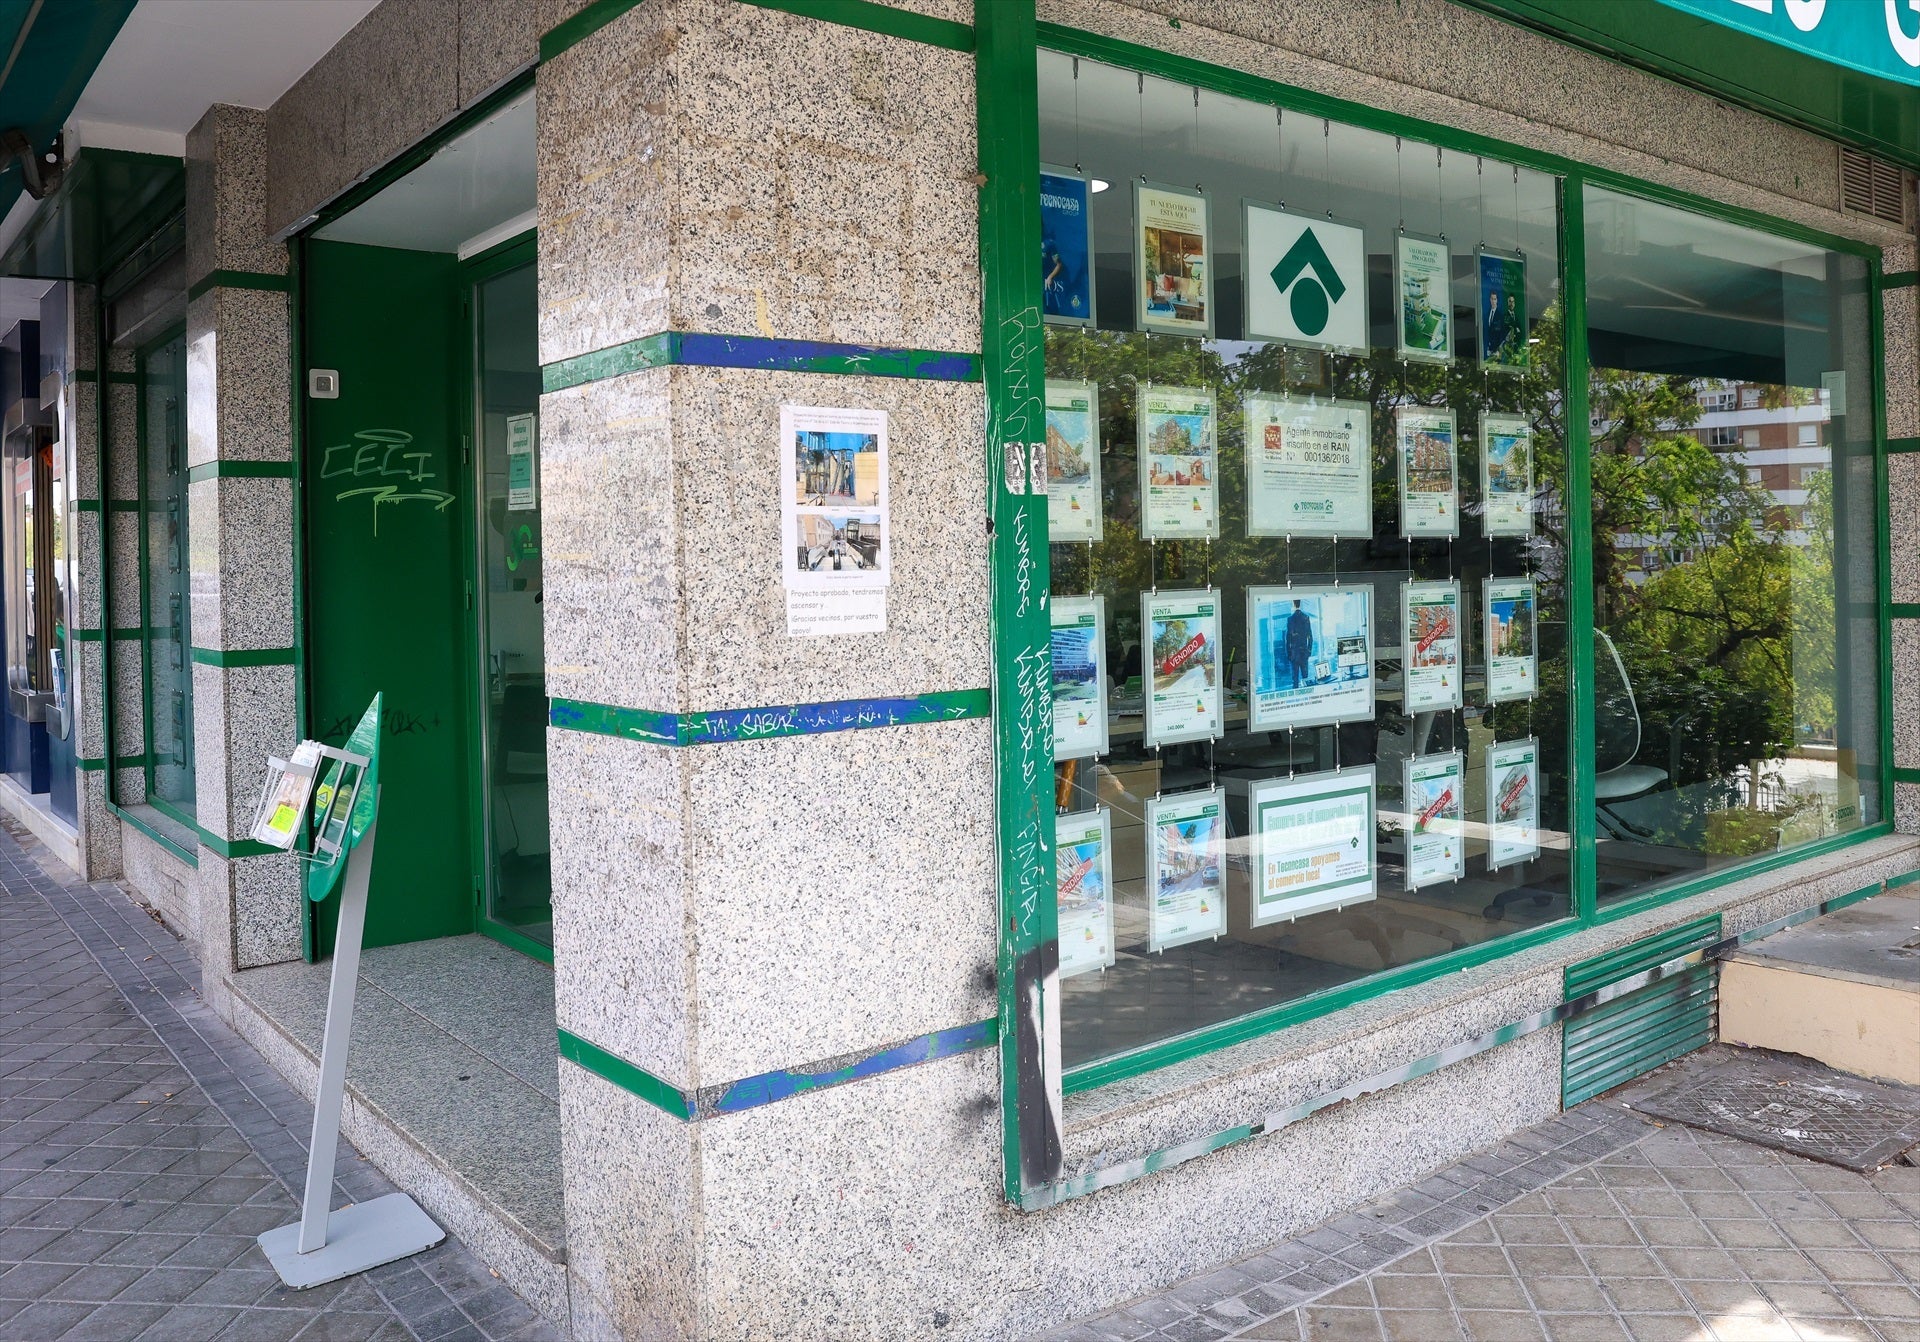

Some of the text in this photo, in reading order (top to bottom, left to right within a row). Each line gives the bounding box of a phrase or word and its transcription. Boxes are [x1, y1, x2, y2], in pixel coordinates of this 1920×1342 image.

[1286, 426, 1350, 440] Agente inmobiliario
[1286, 439, 1350, 452] inscrito en el RAIN
[1304, 451, 1350, 464] 000136/2018
[790, 588, 884, 598] Proyecto aprobado, tendremos
[1152, 607, 1172, 616] VENTA
[1421, 624, 1444, 647] VENDIDO
[1169, 639, 1199, 668] VENDIDO
[1412, 771, 1427, 779] VENTA
[1503, 779, 1526, 808] RESERVADO
[1424, 795, 1447, 821] VENDIDO
[1157, 812, 1177, 821] VENTA
[1268, 862, 1276, 875] En
[1276, 857, 1310, 873] Tecnocasa
[1310, 851, 1341, 869] apoyamos
[1268, 877, 1275, 890] al
[1275, 871, 1305, 888] comercio
